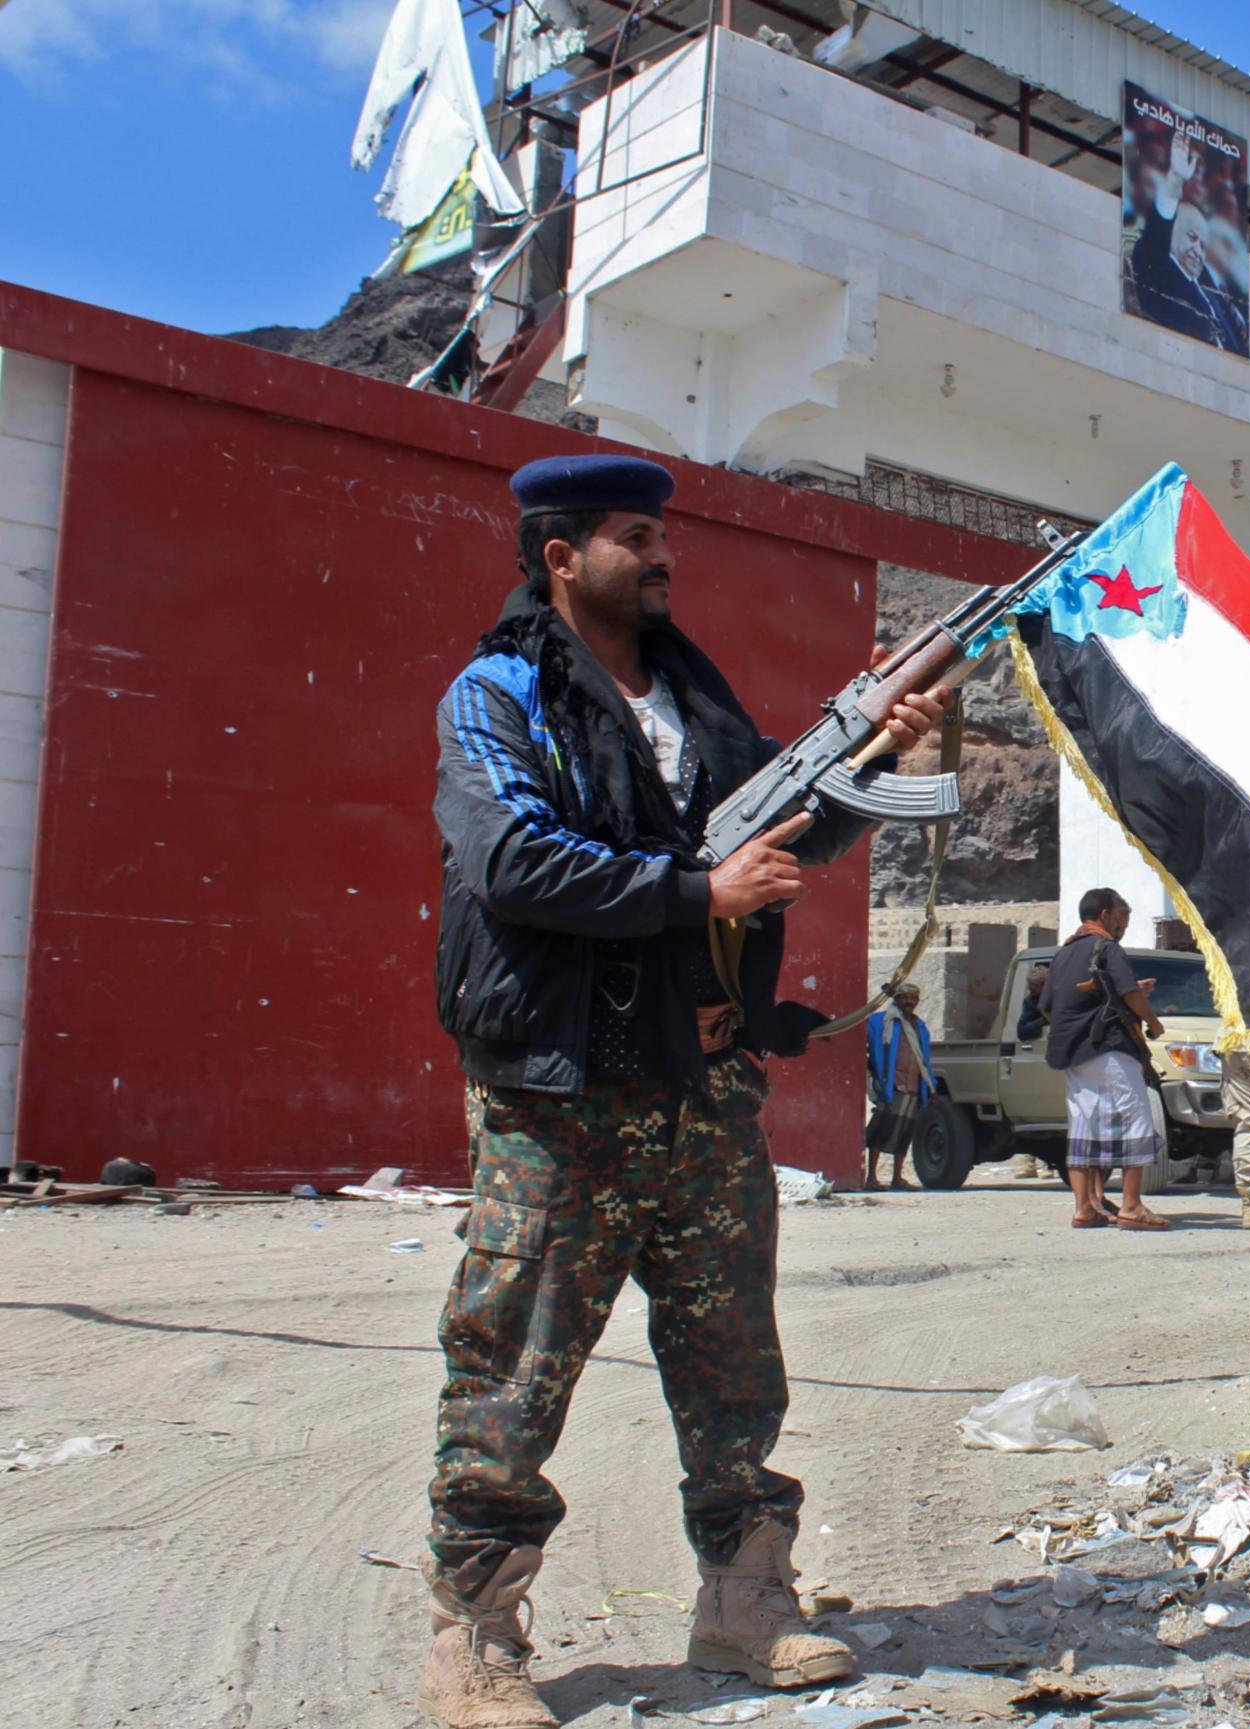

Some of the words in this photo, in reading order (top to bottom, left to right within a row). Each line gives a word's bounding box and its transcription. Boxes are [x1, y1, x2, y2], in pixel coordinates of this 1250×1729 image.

[1133, 98, 1174, 126] هادي
[1175, 115, 1186, 136] يا
[1186, 120, 1206, 142] الله
[1206, 132, 1240, 158] حماك
